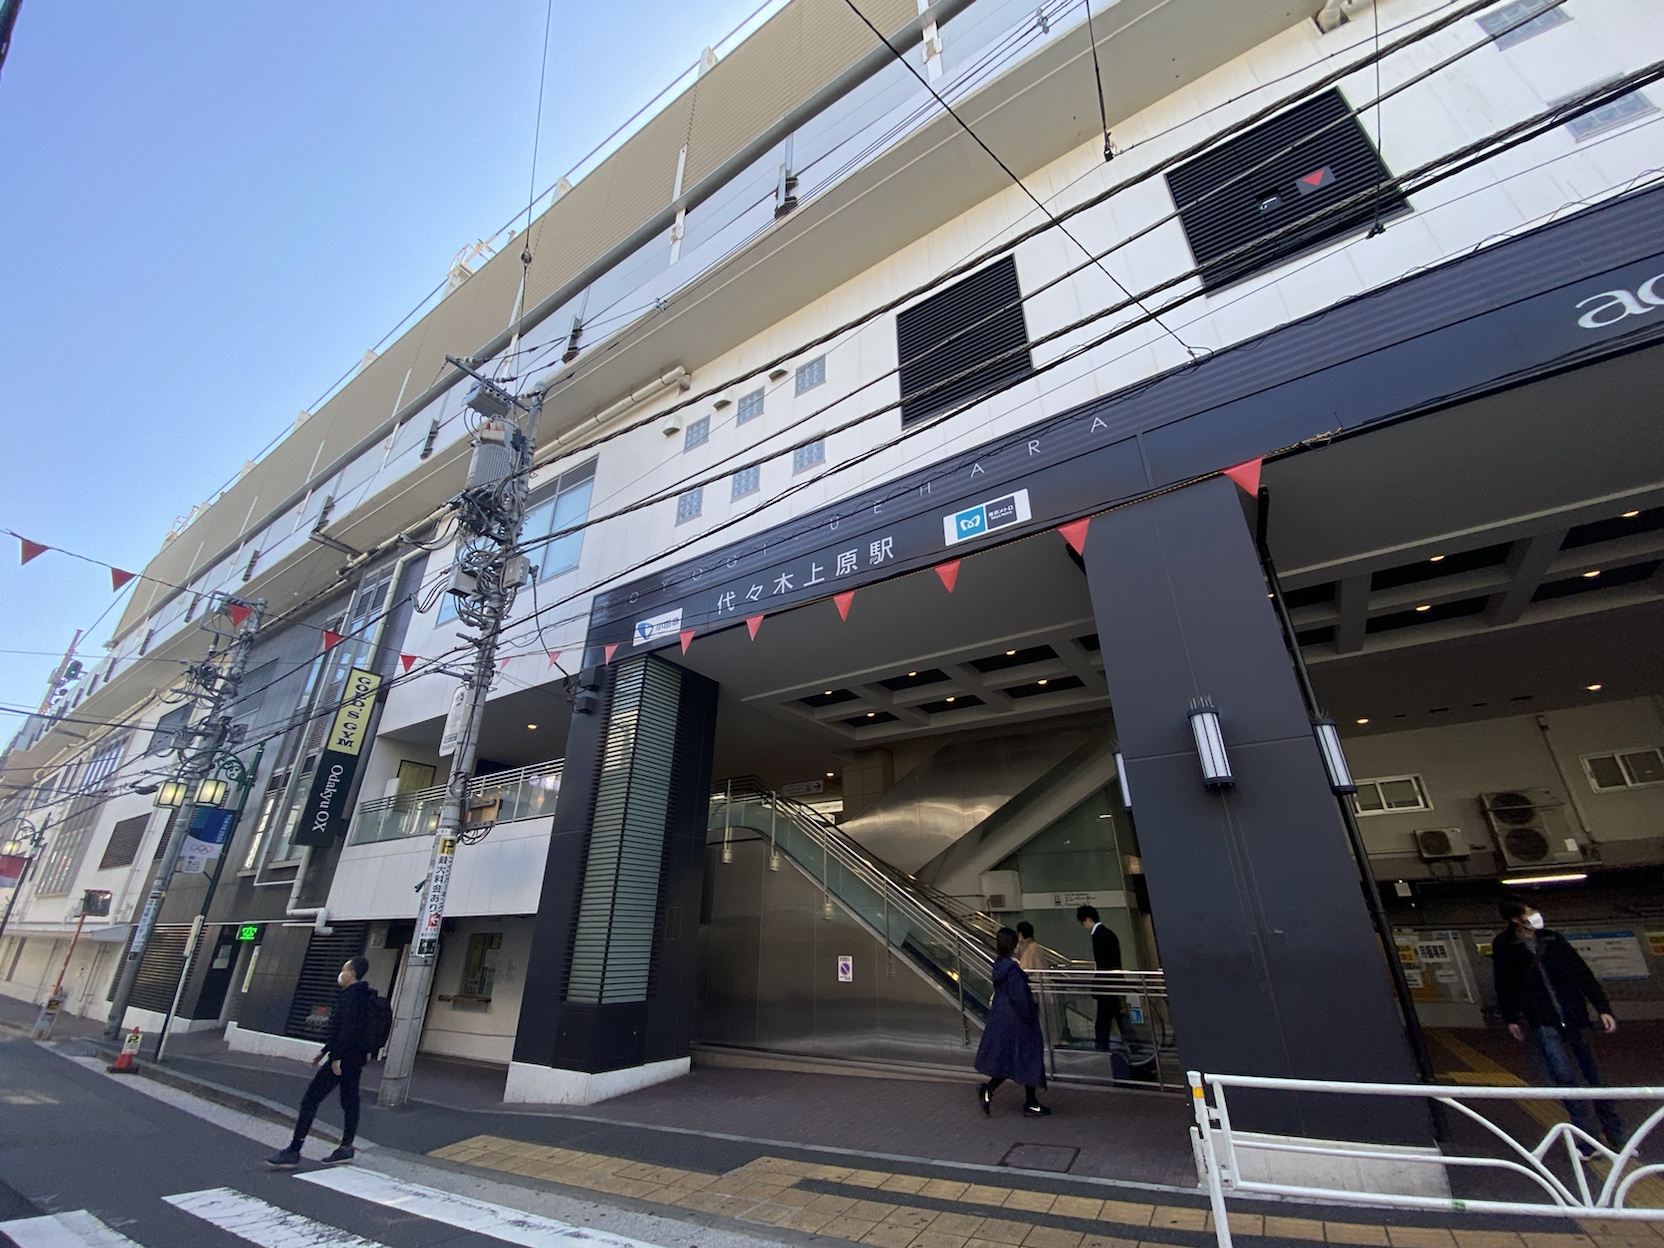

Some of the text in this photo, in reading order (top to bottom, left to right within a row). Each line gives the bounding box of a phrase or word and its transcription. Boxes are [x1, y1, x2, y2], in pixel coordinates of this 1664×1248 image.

[717, 536, 894, 615] 代々木上原駅
[336, 721, 358, 749] GYM
[312, 764, 344, 833] Odakyu OX
[215, 814, 233, 842] TOKYO 2020
[429, 856, 448, 912] 最大料金あり
